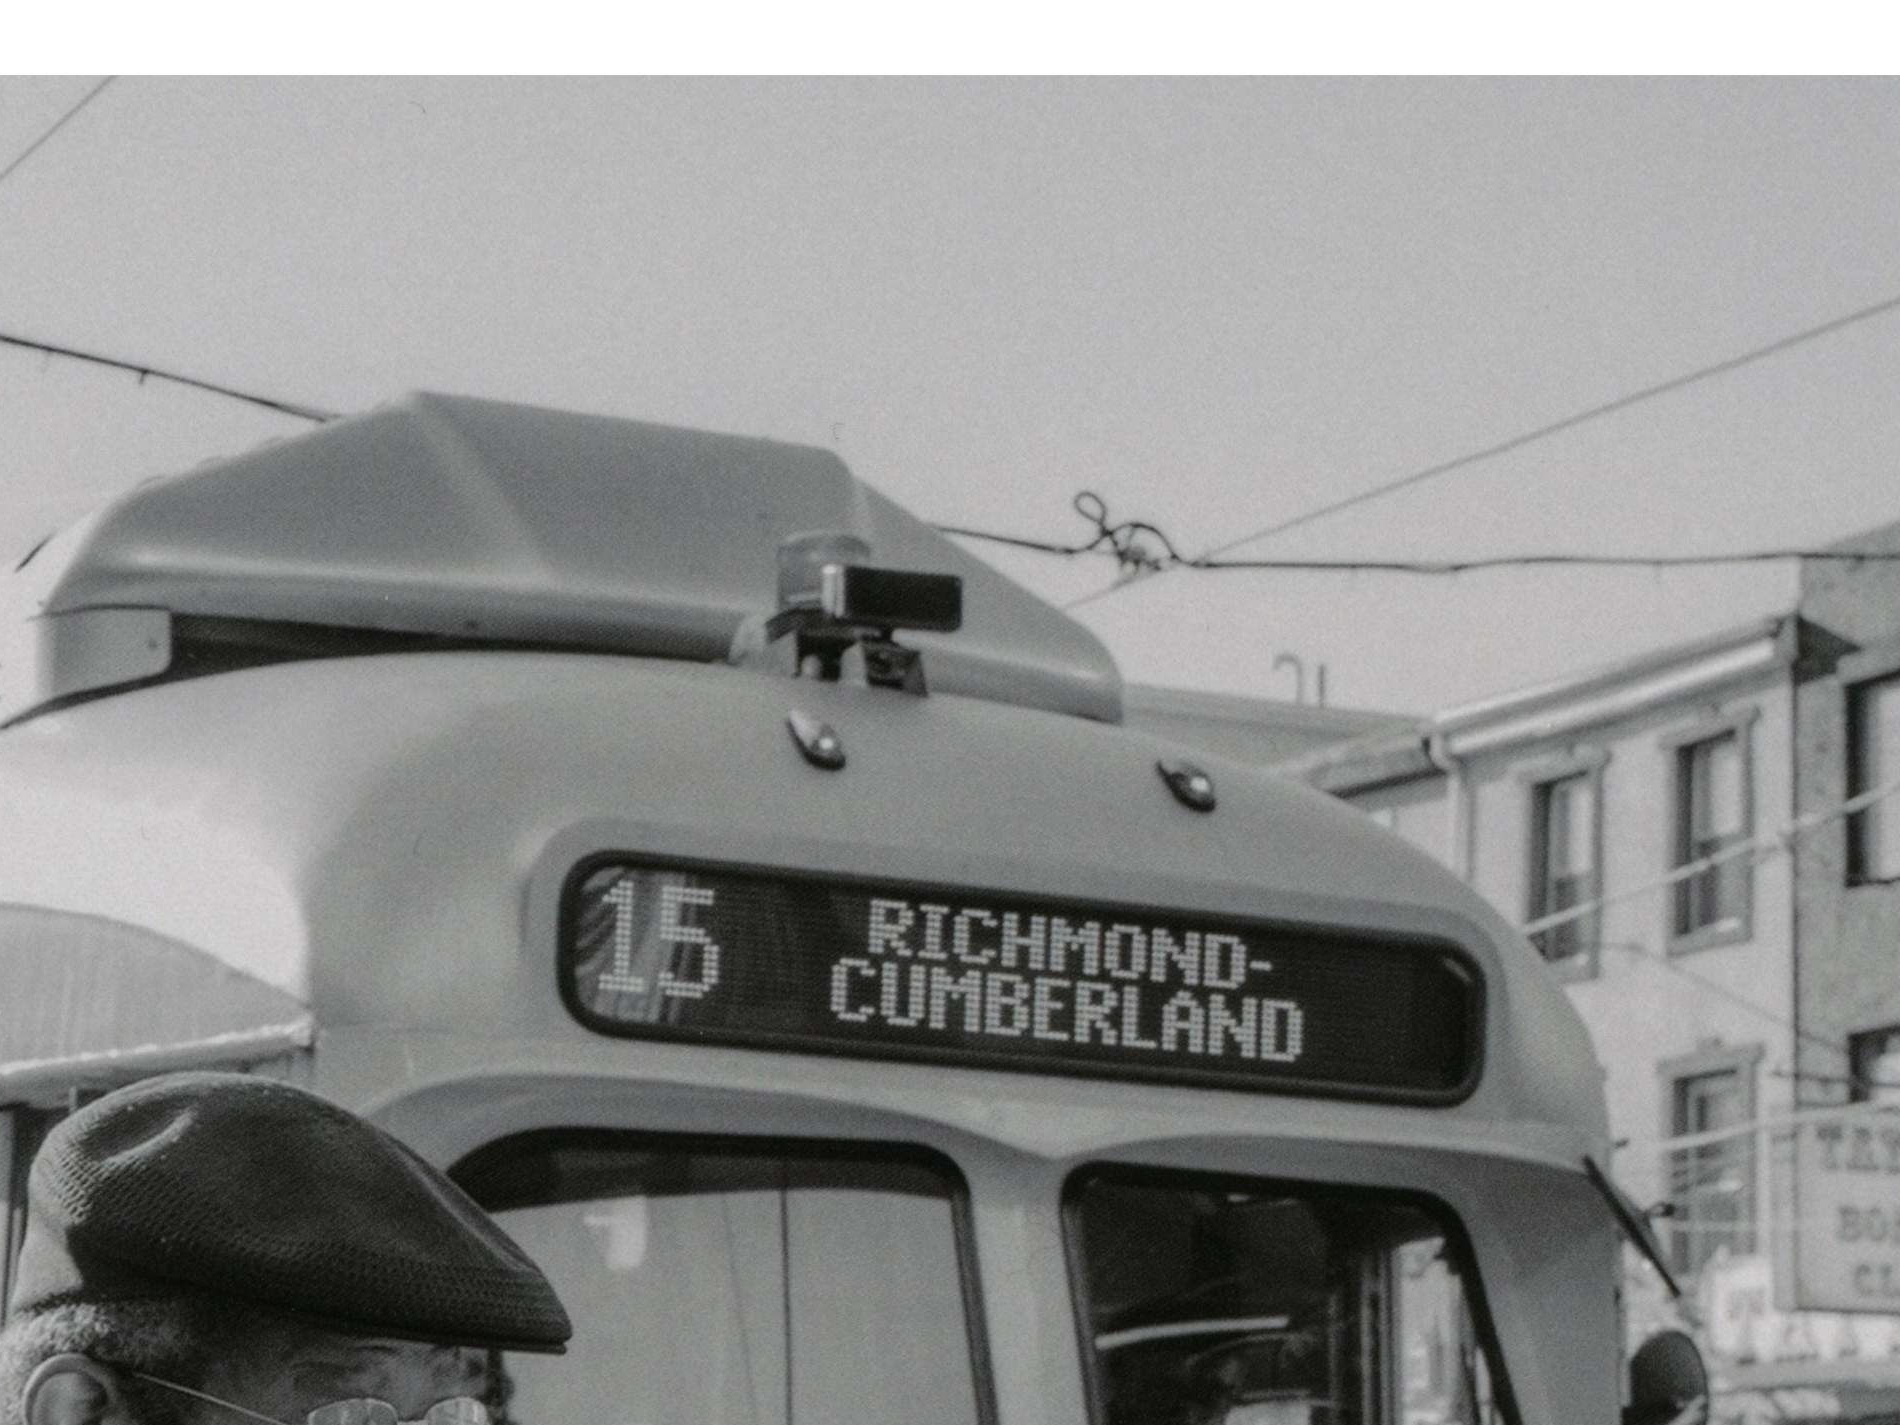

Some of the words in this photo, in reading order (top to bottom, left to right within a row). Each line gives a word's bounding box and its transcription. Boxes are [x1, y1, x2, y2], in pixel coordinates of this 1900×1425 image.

[597, 879, 720, 1000] 15
[866, 898, 1273, 991] RICHMOND-
[830, 957, 1303, 1063] CUMBERLAND
